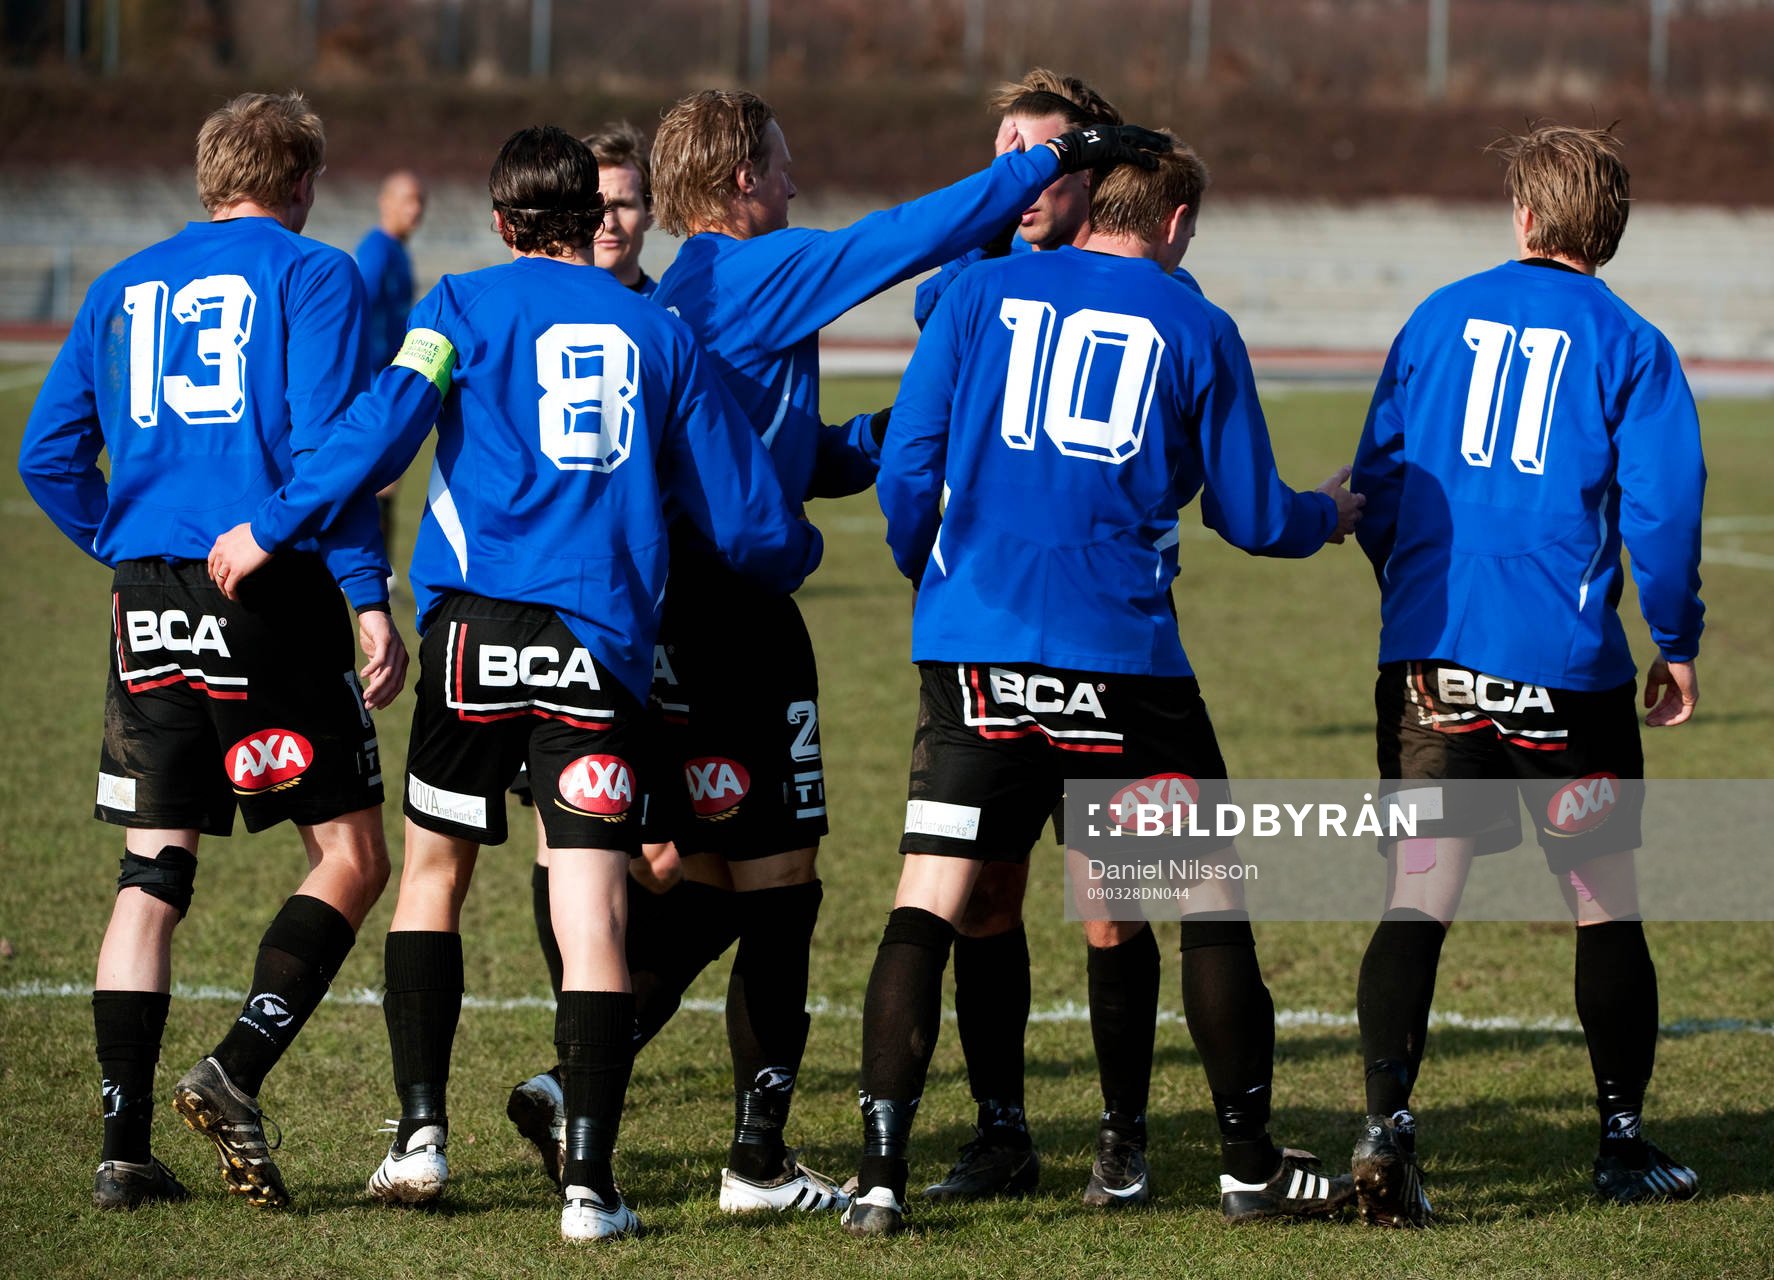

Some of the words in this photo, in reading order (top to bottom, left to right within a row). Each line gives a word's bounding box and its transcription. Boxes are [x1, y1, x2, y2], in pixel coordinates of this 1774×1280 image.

[123, 274, 257, 429] 13
[536, 323, 640, 473] 8
[999, 298, 1166, 464] 10
[1461, 318, 1572, 475] 11
[479, 644, 600, 690] BCA
[1437, 668, 1555, 714] BCA
[234, 734, 306, 781] AXA
[566, 761, 632, 803] AXA
[1556, 777, 1616, 825] AXA
